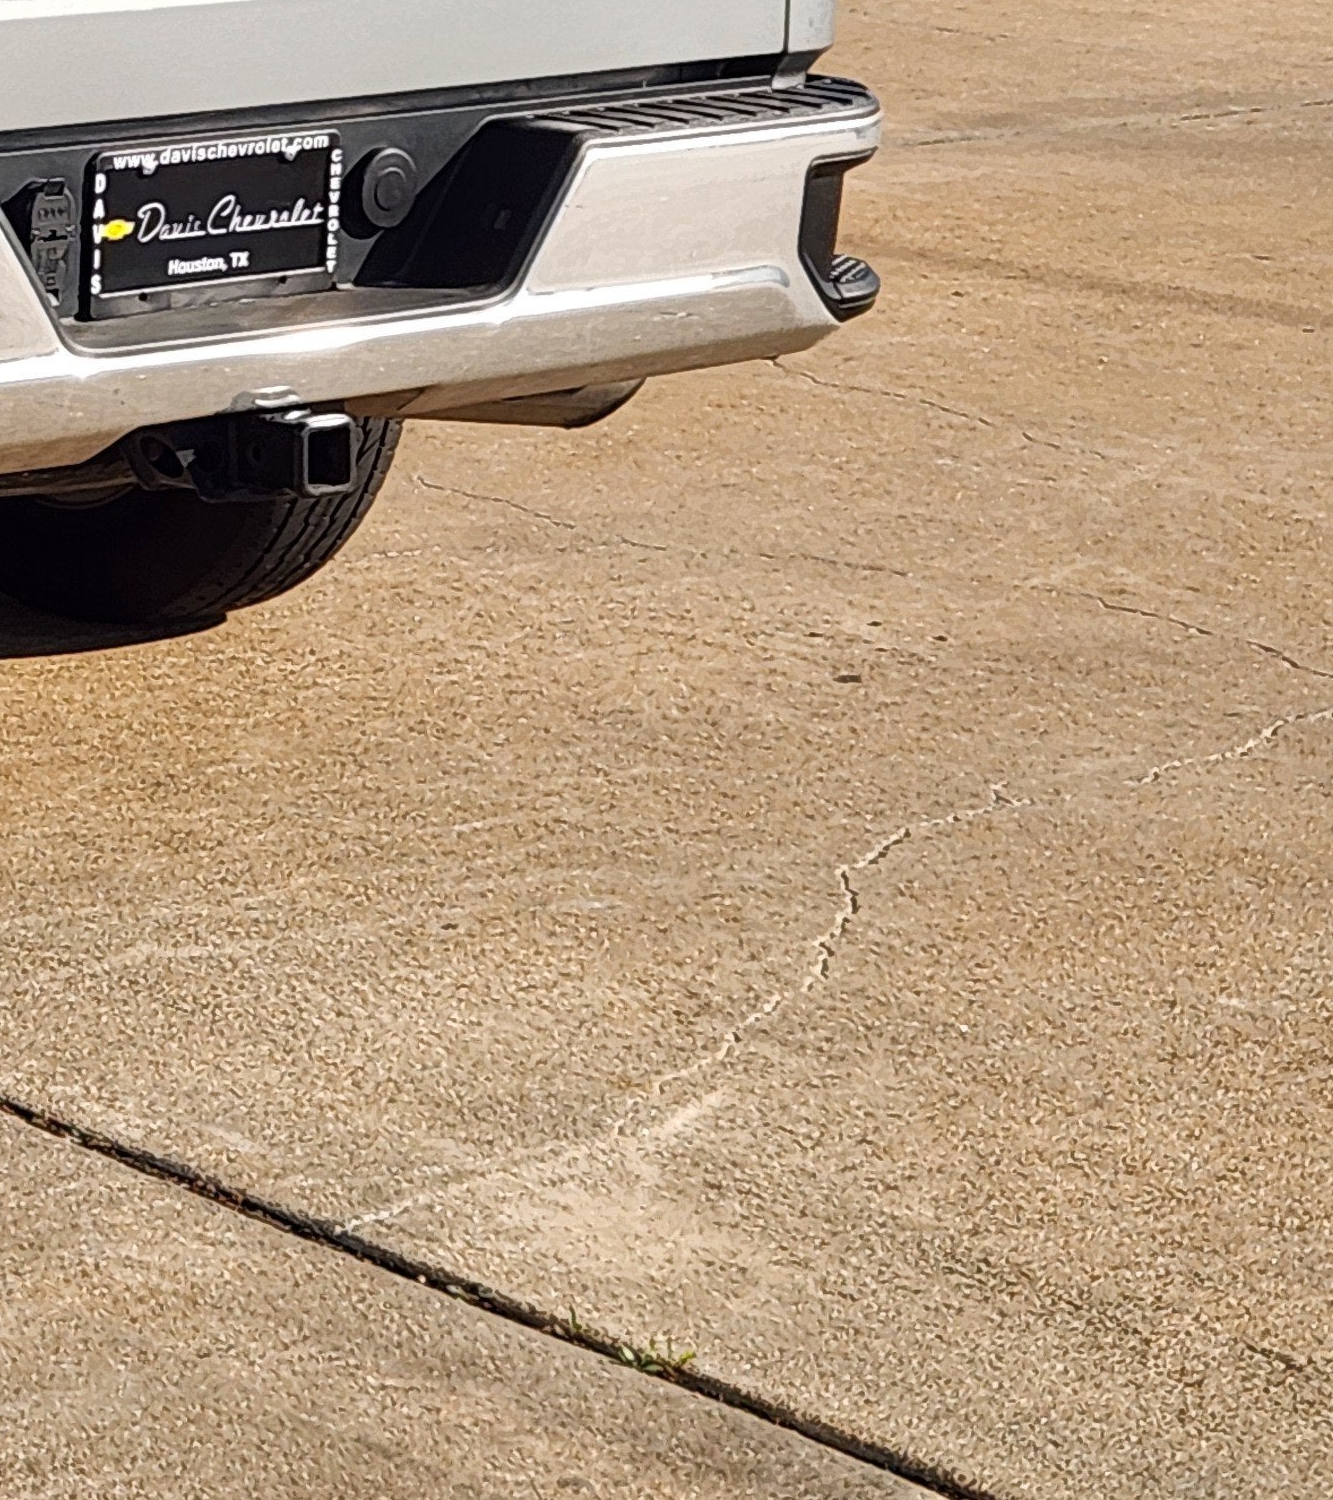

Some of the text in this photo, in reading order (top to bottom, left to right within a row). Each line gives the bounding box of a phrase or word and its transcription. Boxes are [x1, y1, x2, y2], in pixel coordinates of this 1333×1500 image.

[113, 135, 330, 170] www.davischevrolet.com
[90, 172, 107, 295] DAVIS
[136, 193, 325, 243] Davis Chevrolet
[326, 147, 344, 274] CHEVROLET
[167, 250, 250, 276] Houston, TX
